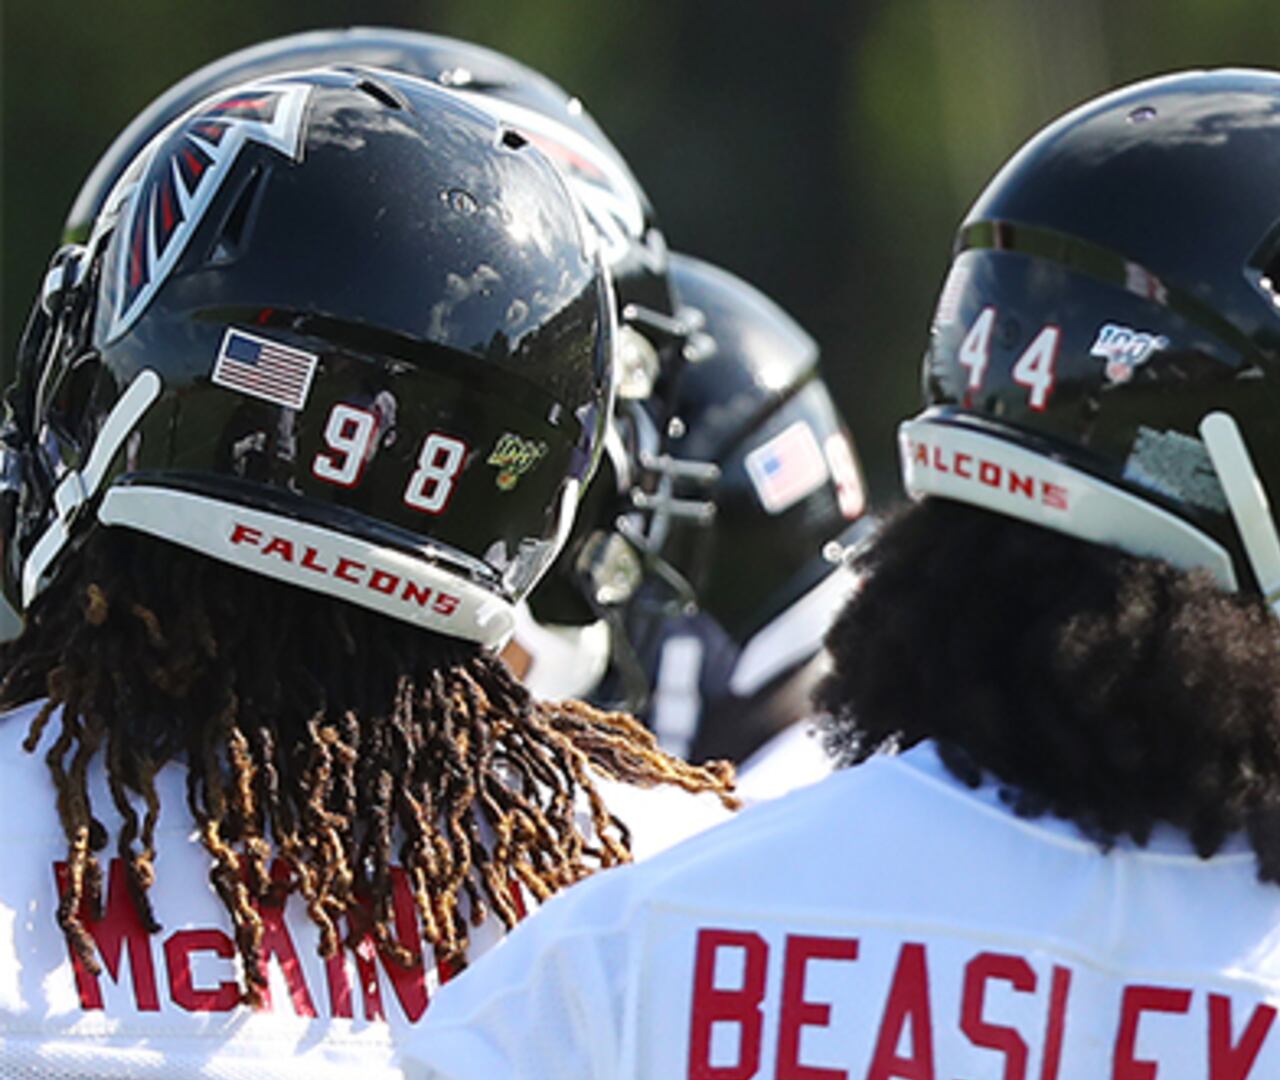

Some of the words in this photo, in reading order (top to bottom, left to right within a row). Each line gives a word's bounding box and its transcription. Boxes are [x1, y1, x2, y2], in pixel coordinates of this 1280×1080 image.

[959, 306, 1062, 413] 44
[313, 403, 467, 516] 98
[910, 440, 1070, 511] ALCONS
[229, 522, 462, 619] FALCONS
